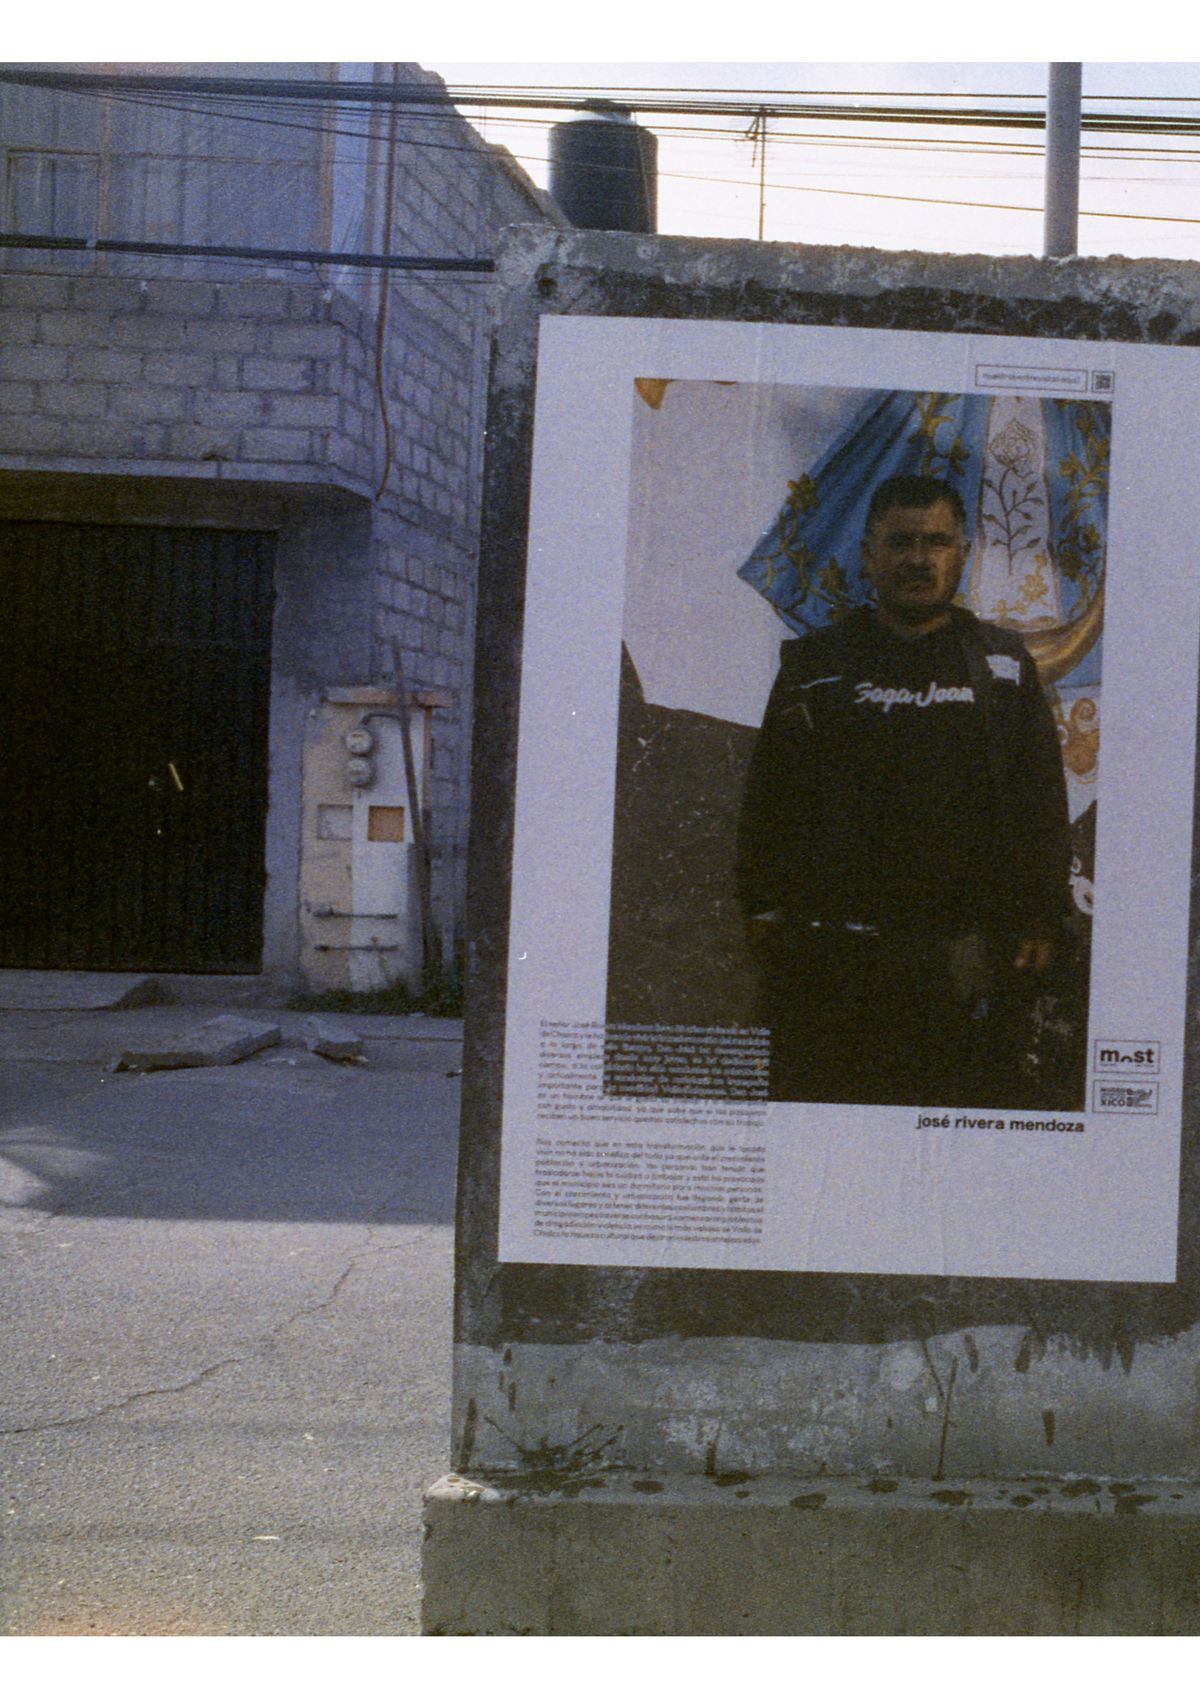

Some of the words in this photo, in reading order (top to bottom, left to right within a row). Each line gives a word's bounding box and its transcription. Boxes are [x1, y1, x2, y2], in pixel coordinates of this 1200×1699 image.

[916, 1115, 950, 1129] josé
[955, 1116, 1005, 1130] rivera
[1009, 1119, 1085, 1133] mendoza
